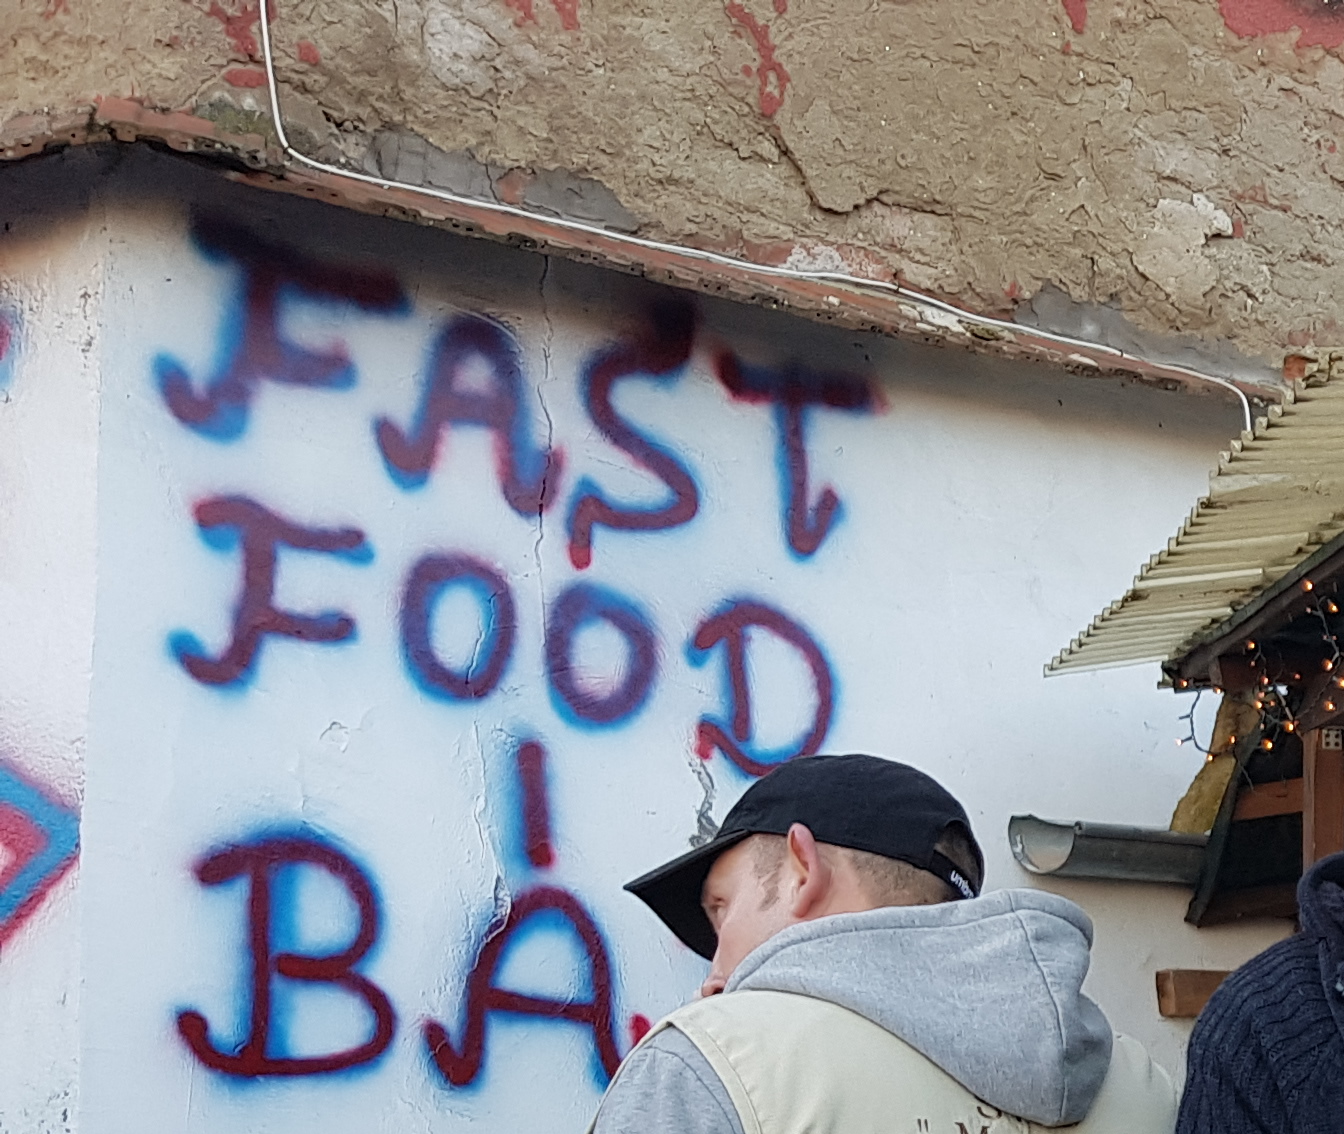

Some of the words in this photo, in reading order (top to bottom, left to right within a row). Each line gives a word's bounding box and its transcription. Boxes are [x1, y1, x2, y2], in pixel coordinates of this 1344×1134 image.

[153, 212, 888, 570] FAST
[168, 495, 838, 778] FOOD
[176, 818, 652, 1088] BA
